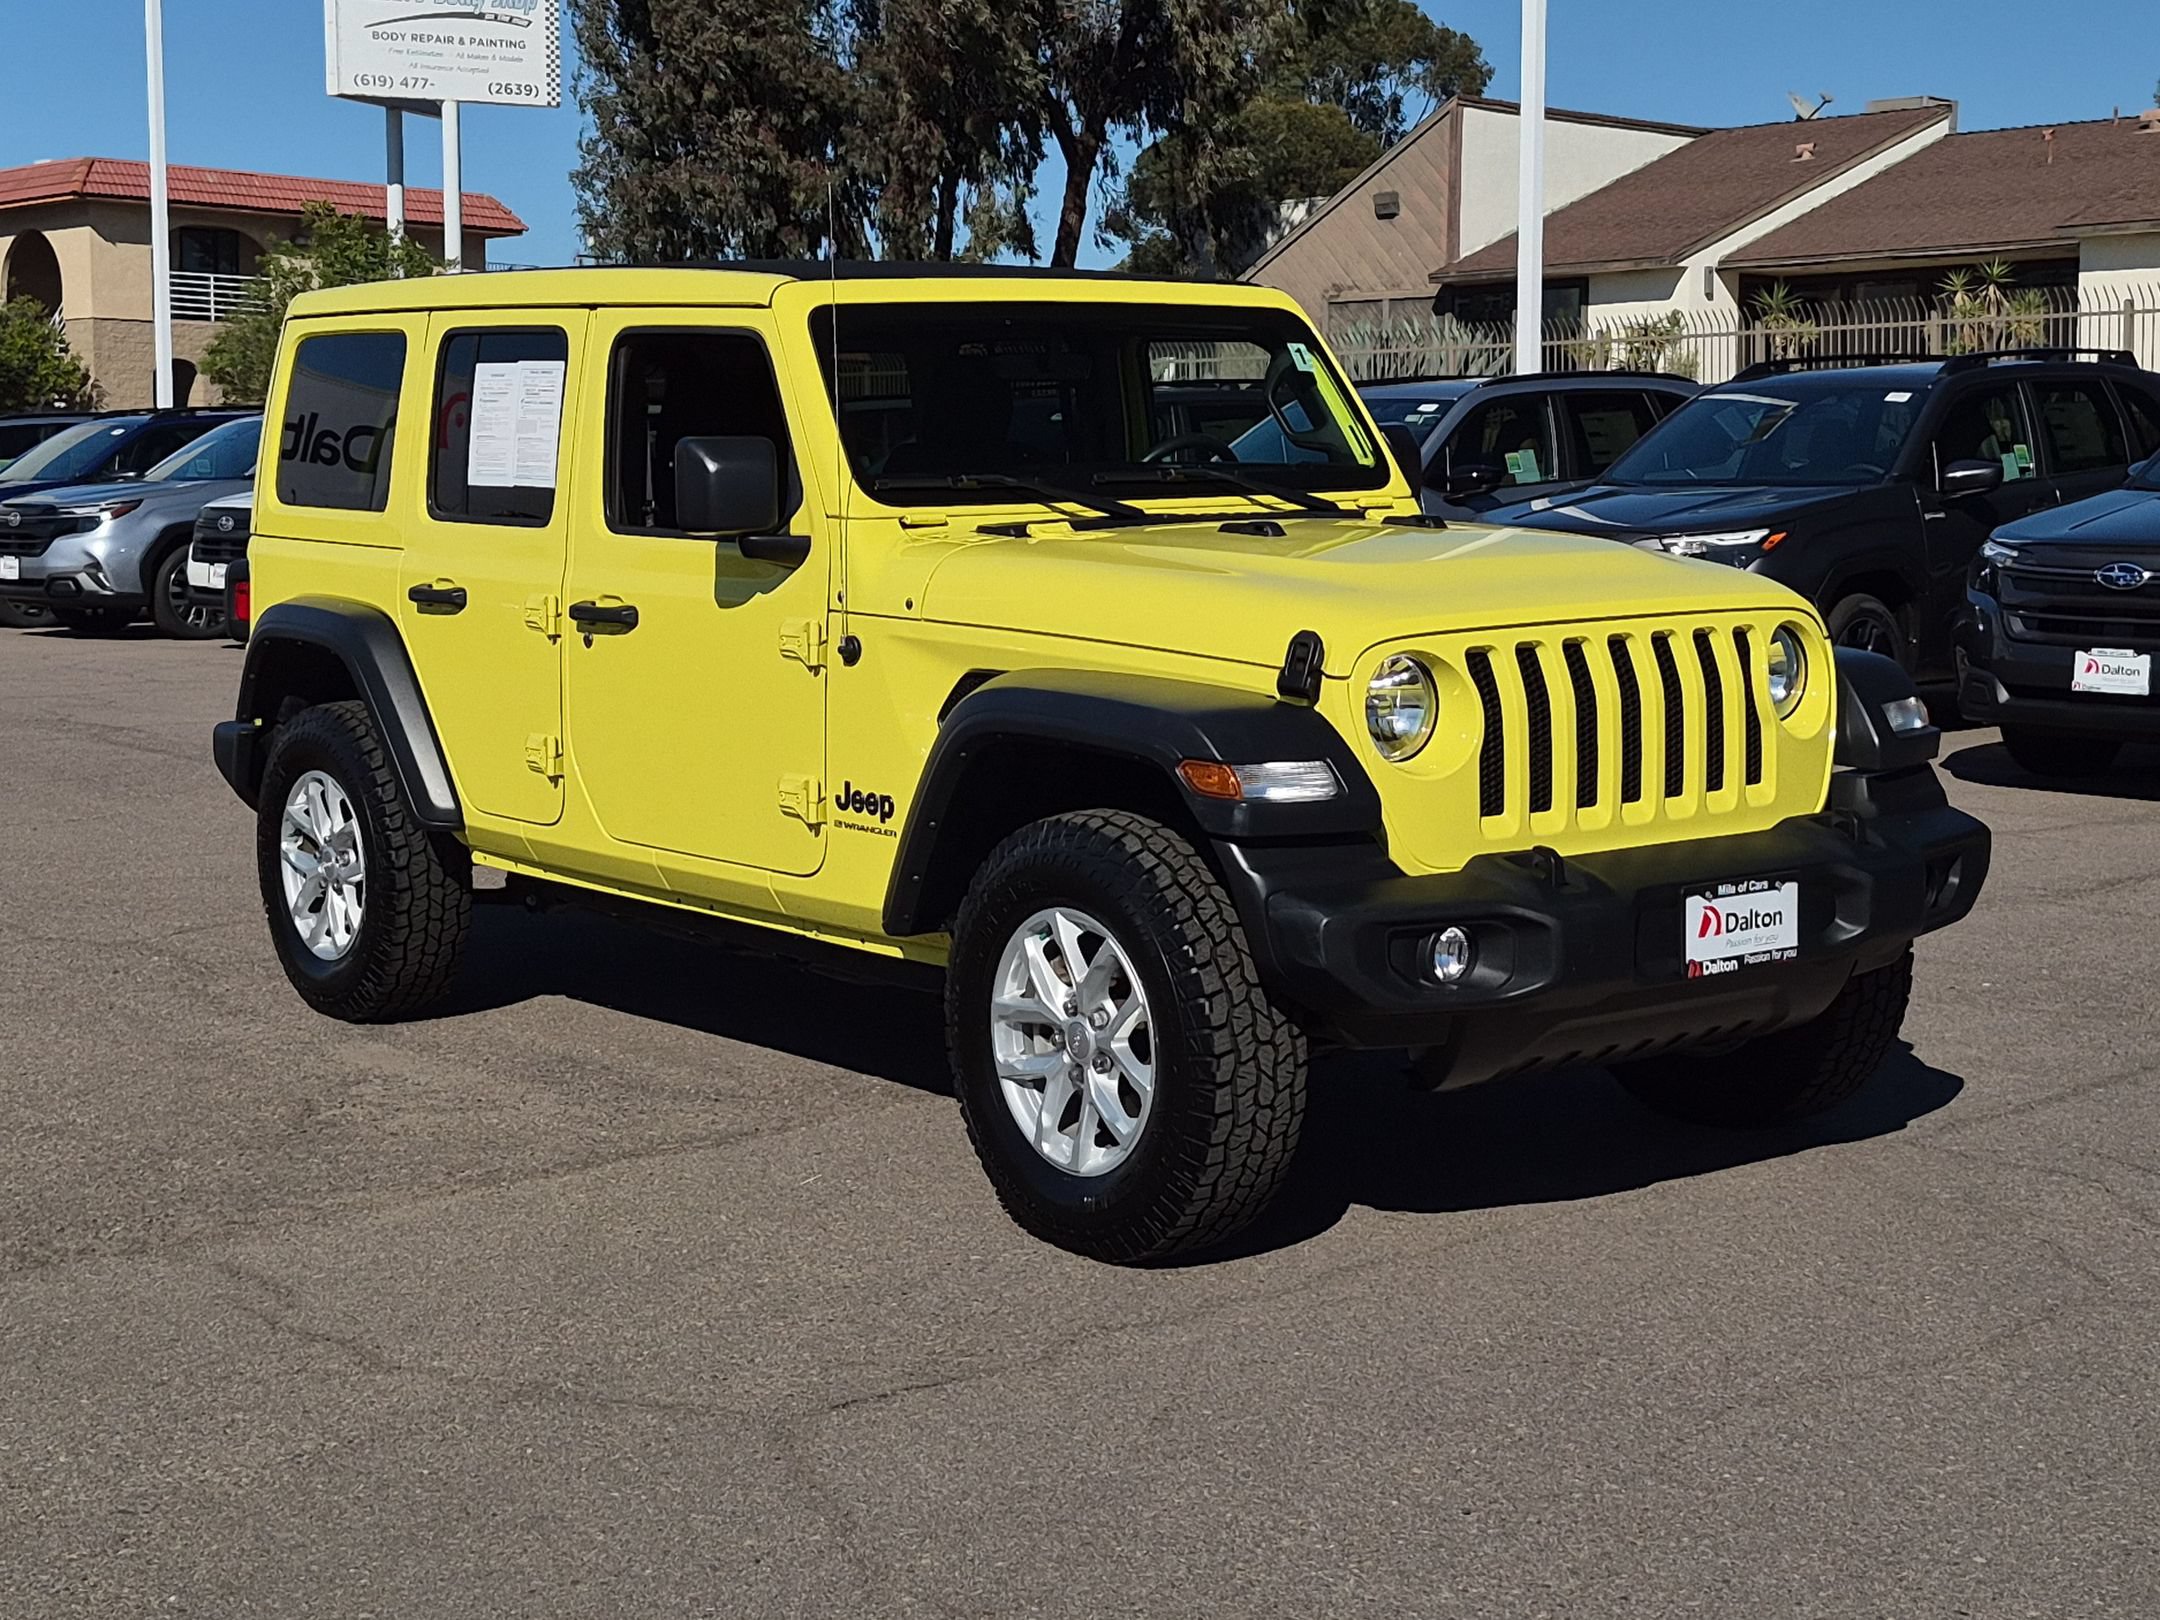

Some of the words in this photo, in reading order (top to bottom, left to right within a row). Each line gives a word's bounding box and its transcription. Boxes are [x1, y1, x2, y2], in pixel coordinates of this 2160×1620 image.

[371, 31, 407, 42] BODY
[411, 33, 455, 46] REPAIR
[458, 36, 466, 46] &
[469, 38, 527, 50] PAINTING
[353, 73, 394, 89] (619)
[399, 77, 436, 90] 477-
[487, 82, 540, 98] (2639)
[2101, 663, 2140, 676] Dalton
[835, 780, 895, 825] Jeep
[844, 821, 897, 838] WRANGLER
[1718, 883, 1736, 896] Mile
[1737, 881, 1747, 893] of
[1748, 880, 1769, 892] Cars
[1726, 908, 1782, 933] Dalton
[1702, 960, 1738, 976] Dalton
[1771, 949, 1782, 960] for
[1783, 948, 1798, 960] you
